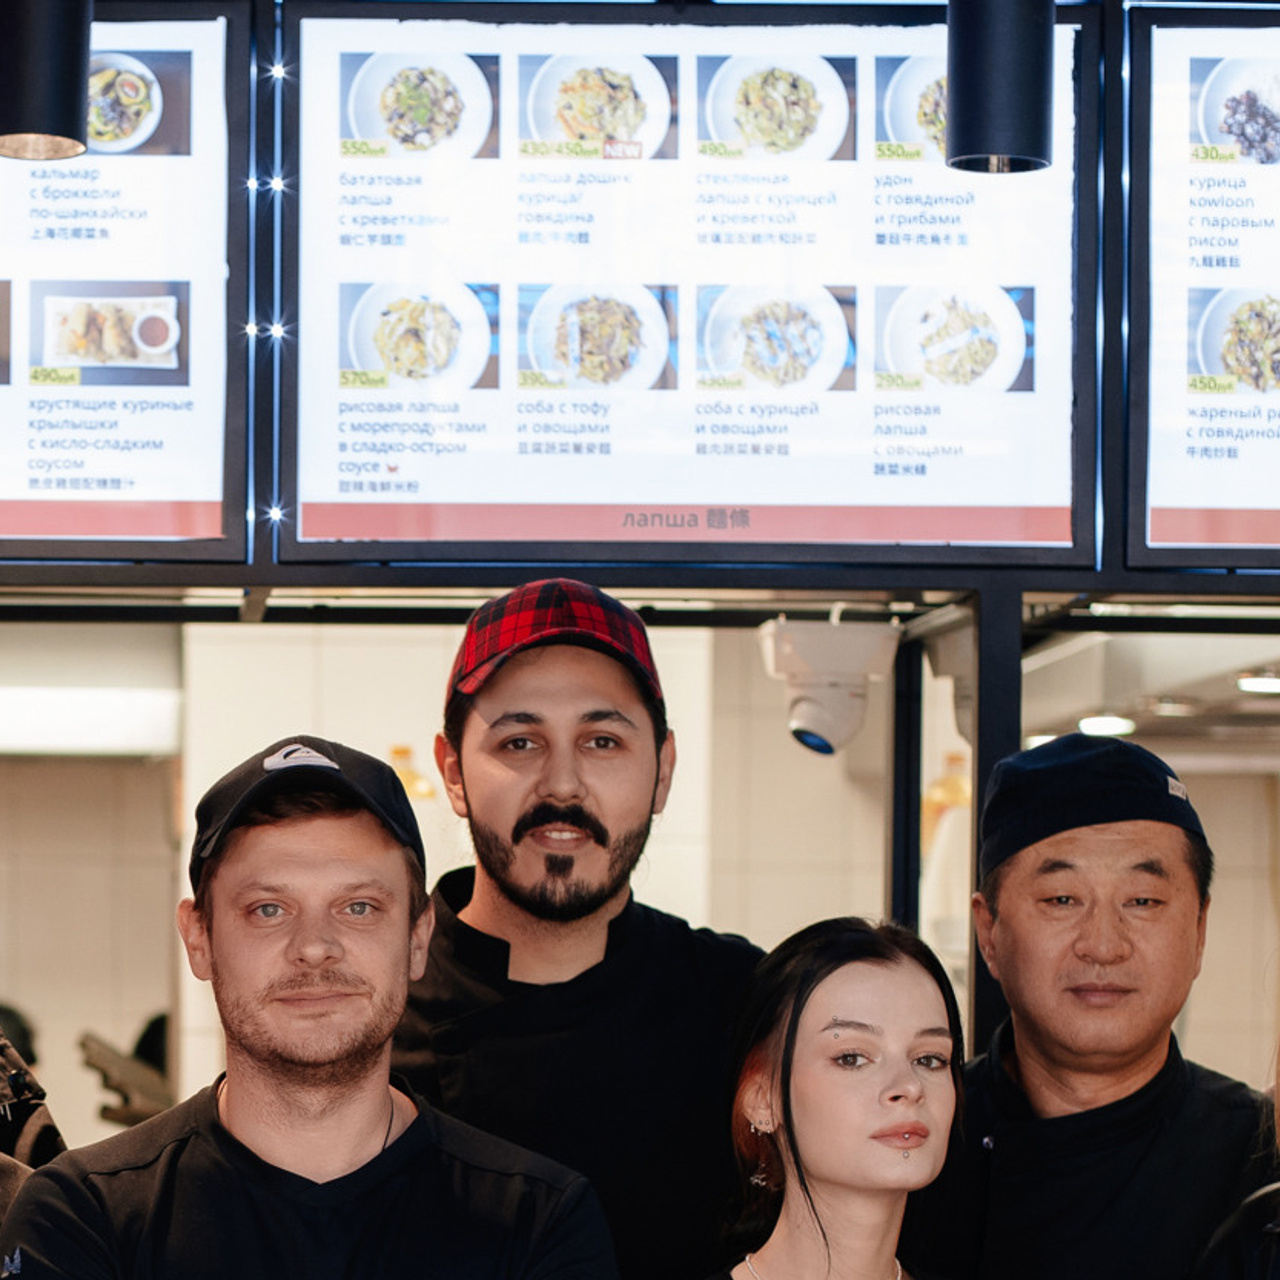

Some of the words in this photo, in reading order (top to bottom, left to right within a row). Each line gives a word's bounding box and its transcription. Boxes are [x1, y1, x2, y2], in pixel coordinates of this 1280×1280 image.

[605, 142, 640, 157] NEW
[30, 169, 100, 182] кальмар
[339, 172, 422, 186] бататовая
[874, 175, 913, 189] удон
[1189, 177, 1246, 191] курица
[29, 188, 37, 200] с
[41, 185, 120, 202] брокколи
[339, 195, 393, 206] лапша
[696, 193, 749, 205] лапша
[874, 195, 880, 205] с
[887, 192, 975, 208] говядиной
[1189, 196, 1254, 208] kowloon
[338, 216, 346, 227] с
[874, 215, 885, 224] и
[890, 210, 961, 228] грибами
[1189, 216, 1195, 227] с
[1201, 216, 1275, 231] паровым
[1189, 236, 1239, 248] рисом
[29, 399, 117, 413] хрустящие
[122, 400, 194, 414] куриные
[338, 401, 404, 416] рисовая
[407, 402, 460, 413] лапша
[516, 400, 554, 414] соба
[559, 403, 567, 414] с
[572, 400, 610, 418] тофу
[695, 401, 732, 416] соба
[737, 404, 744, 415] с
[750, 402, 819, 418] курицей
[873, 405, 941, 419] рисовая
[1187, 405, 1262, 421] жареный
[28, 419, 118, 432] крылышки
[338, 422, 346, 432] с
[517, 423, 527, 433] и
[532, 423, 610, 436] овощами
[694, 424, 706, 434] и
[710, 423, 788, 437] овощами
[874, 424, 927, 436] лапша
[1187, 429, 1194, 438] с
[28, 439, 35, 450] с
[40, 438, 164, 452] кисло-сладким
[339, 442, 347, 453] в
[27, 458, 85, 473] соусом
[338, 461, 381, 475] соусе
[622, 510, 698, 528] лапша
